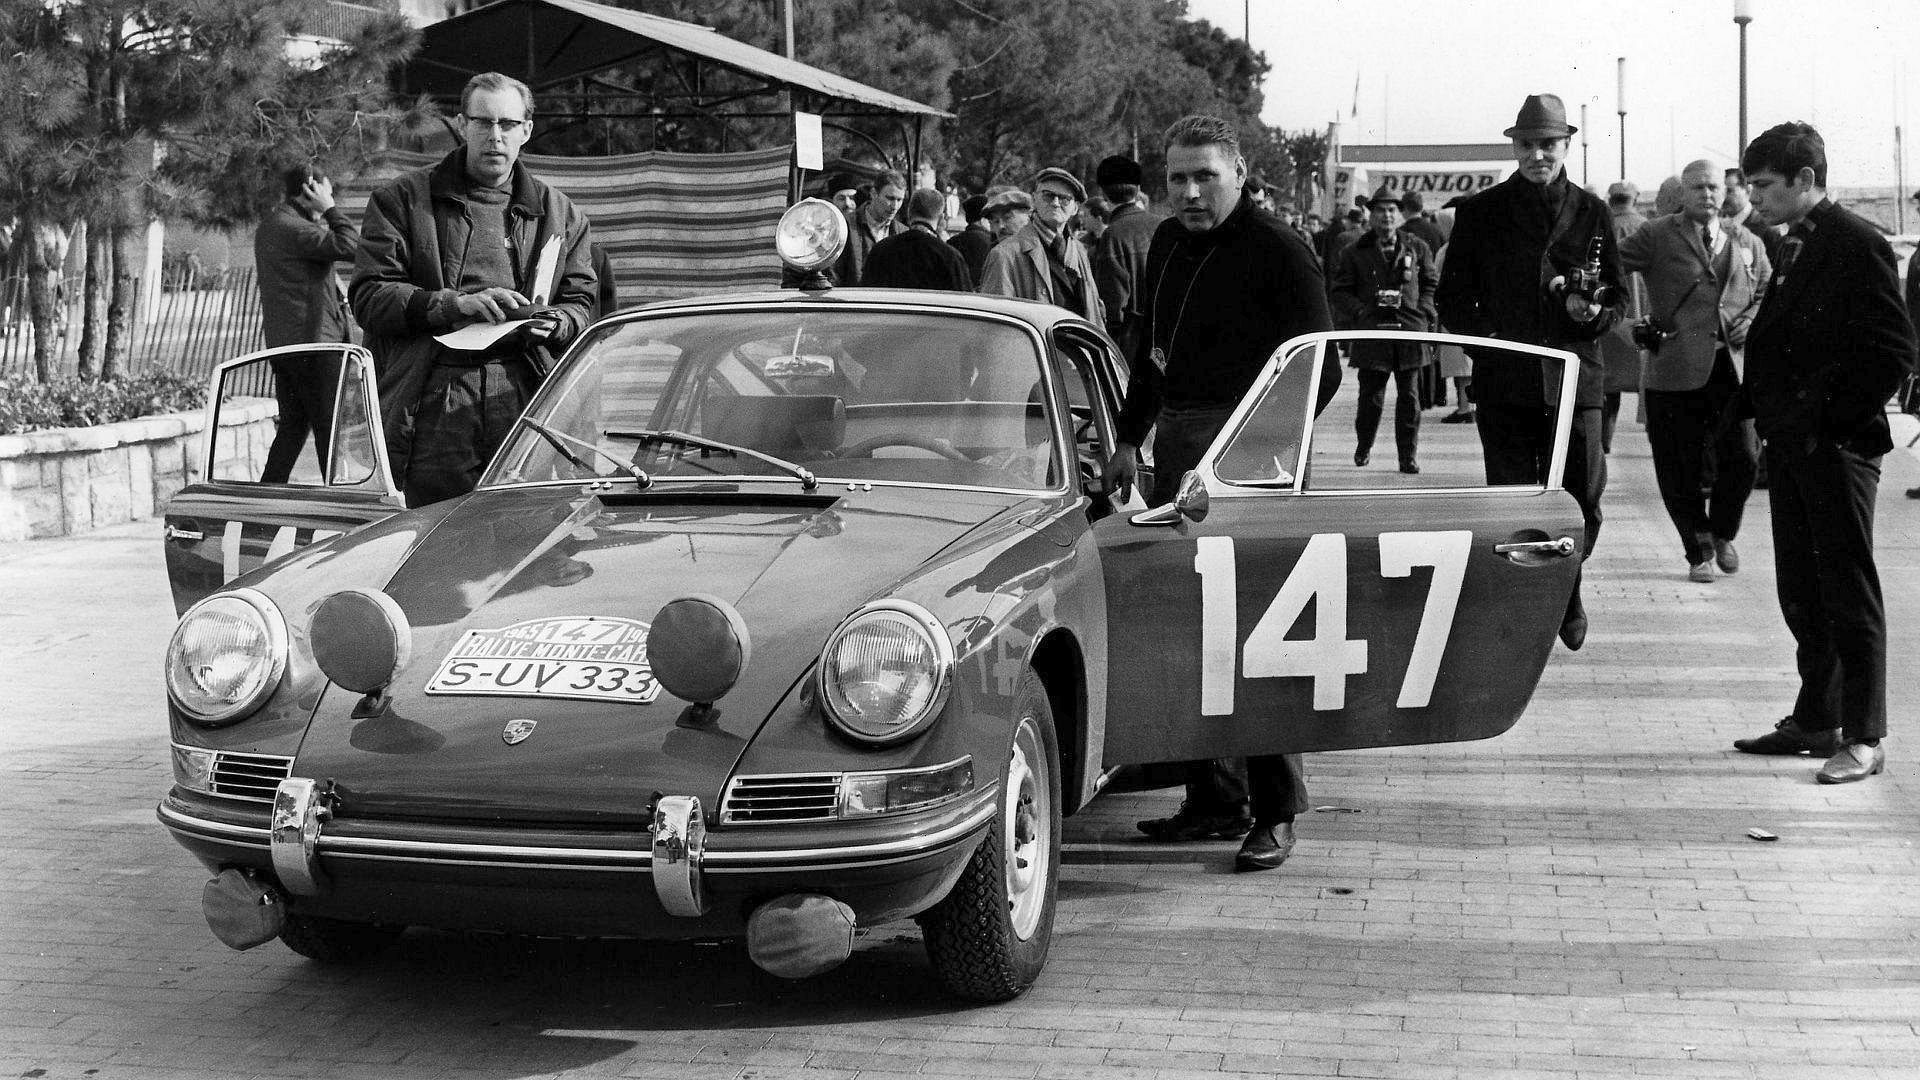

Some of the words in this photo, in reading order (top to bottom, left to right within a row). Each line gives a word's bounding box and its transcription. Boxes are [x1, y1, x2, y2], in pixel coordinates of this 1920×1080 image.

[1383, 175, 1494, 191] DUNLOP
[504, 623, 544, 640] 1965
[545, 623, 623, 642] 147
[1195, 530, 1473, 716] 147
[460, 634, 533, 657] RALLYE
[532, 642, 648, 662] MONTE-CAR
[441, 662, 567, 688] S-UV
[570, 666, 654, 694] 333
